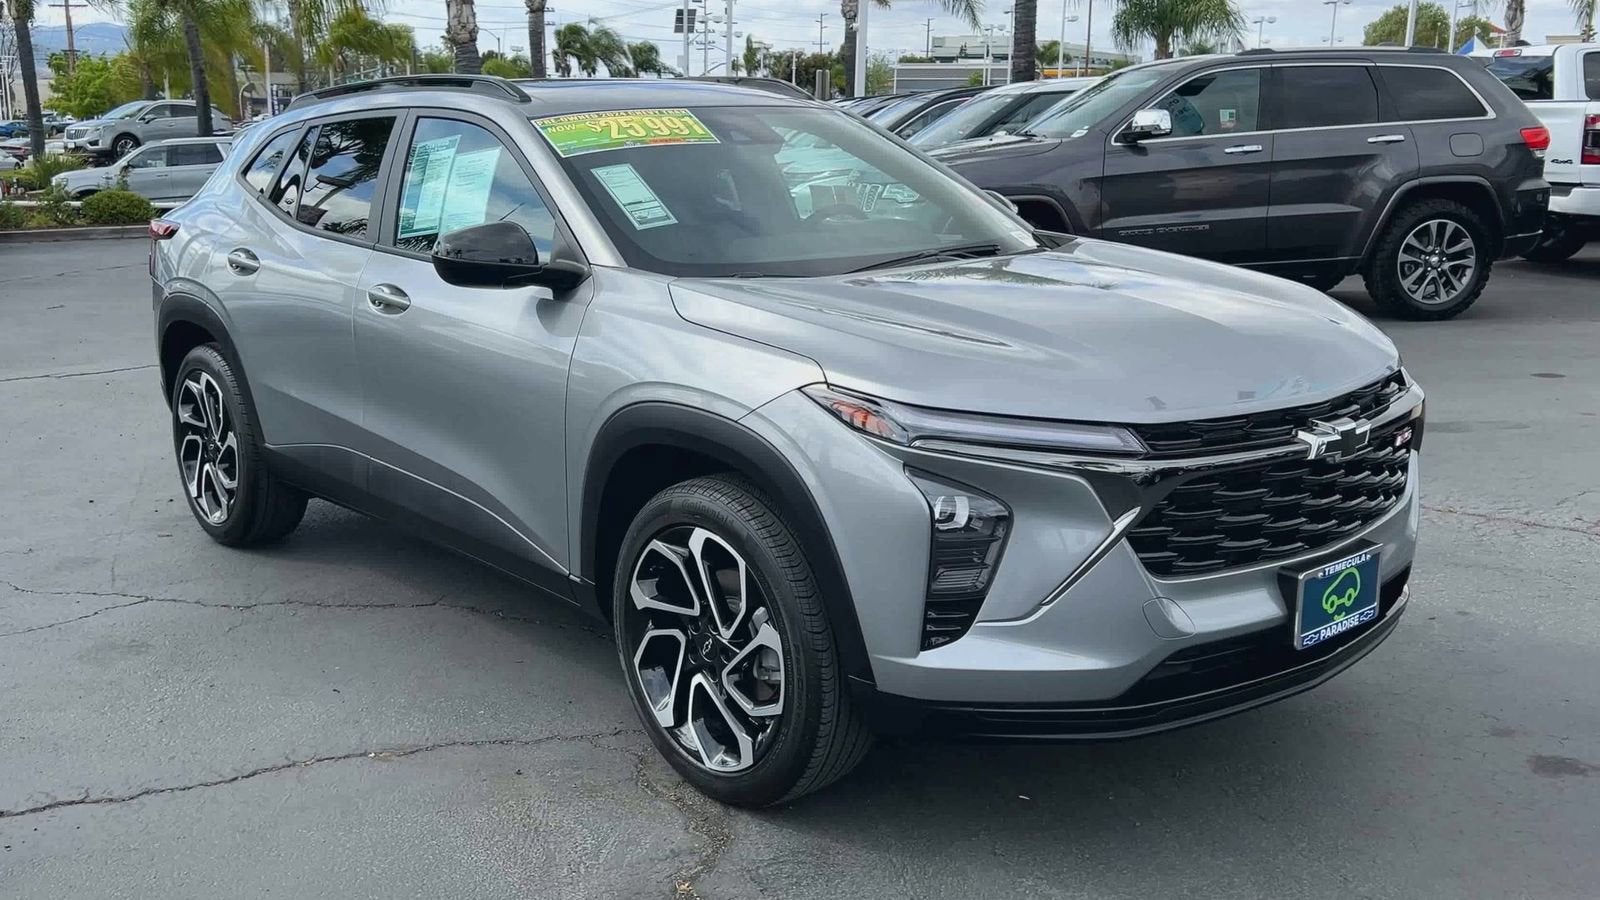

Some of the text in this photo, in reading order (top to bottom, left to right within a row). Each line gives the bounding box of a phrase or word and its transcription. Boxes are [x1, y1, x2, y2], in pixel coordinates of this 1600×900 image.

[548, 123, 577, 134] NOW
[1324, 553, 1367, 577] TEMECULA
[1319, 614, 1360, 641] PARADISE
